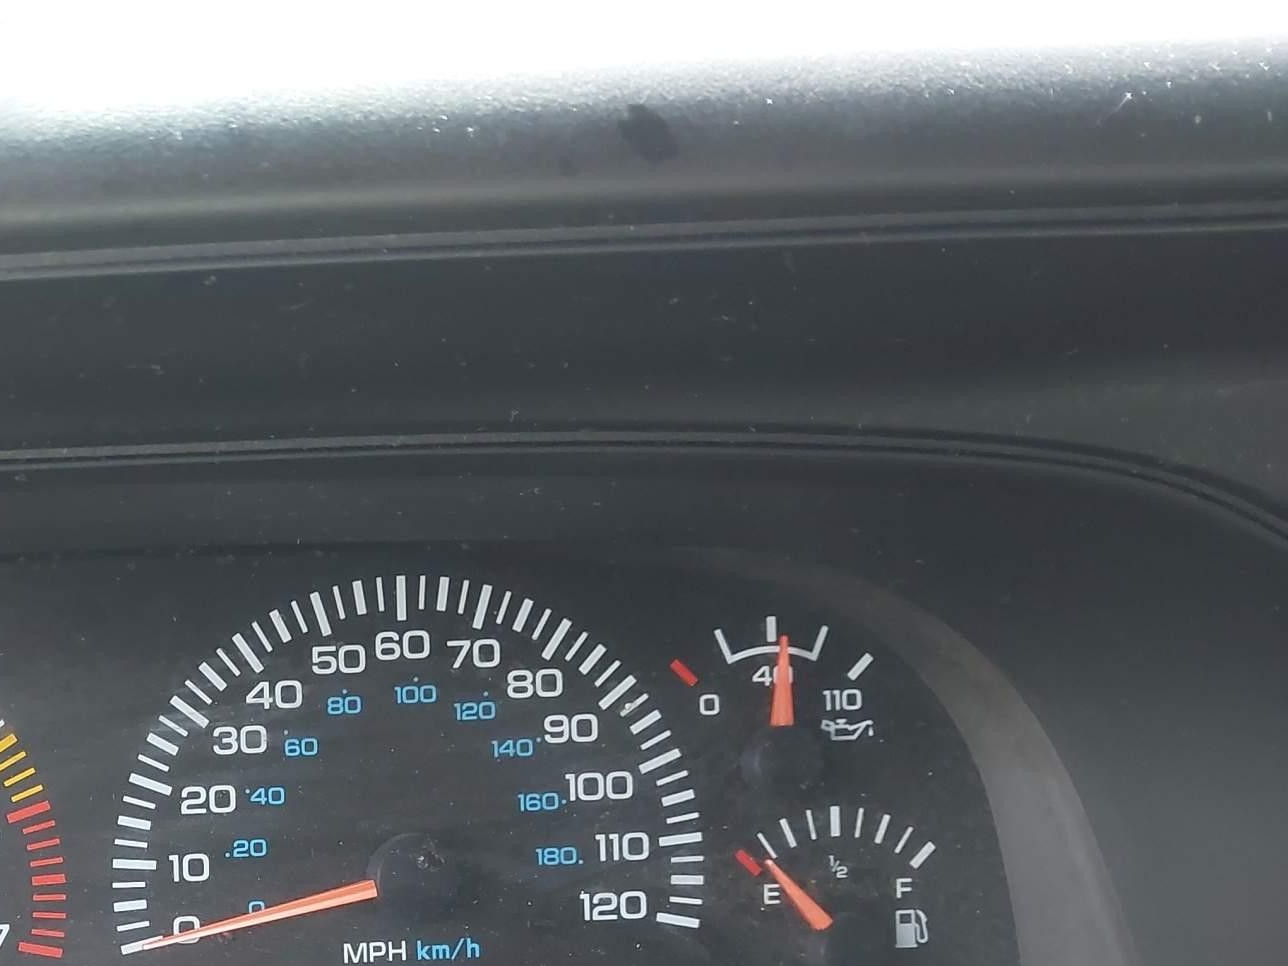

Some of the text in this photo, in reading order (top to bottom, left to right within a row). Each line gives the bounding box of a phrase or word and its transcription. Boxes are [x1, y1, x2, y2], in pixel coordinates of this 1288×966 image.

[375, 631, 430, 660] 60
[446, 639, 501, 668] 70
[312, 645, 366, 674] 50
[246, 680, 302, 709] 40
[394, 685, 436, 703] 100
[506, 669, 562, 697] 80
[327, 696, 361, 715] 80
[454, 702, 496, 720] 120
[700, 695, 720, 715] 0
[823, 689, 862, 711] 110
[213, 725, 267, 754] 30
[544, 714, 598, 743] 90
[284, 738, 318, 756] 60
[491, 739, 533, 757] 140
[250, 787, 285, 805] 40
[565, 771, 633, 801] 100
[180, 785, 236, 814] 20
[518, 792, 559, 811] 160
[232, 839, 267, 857] 20
[536, 847, 577, 865] 180
[595, 832, 649, 862] 110
[169, 853, 209, 882] 10
[764, 884, 781, 904] E
[897, 879, 912, 899] F
[581, 891, 646, 920] 120
[173, 916, 200, 944] 0
[343, 938, 480, 963] MPH km/h
